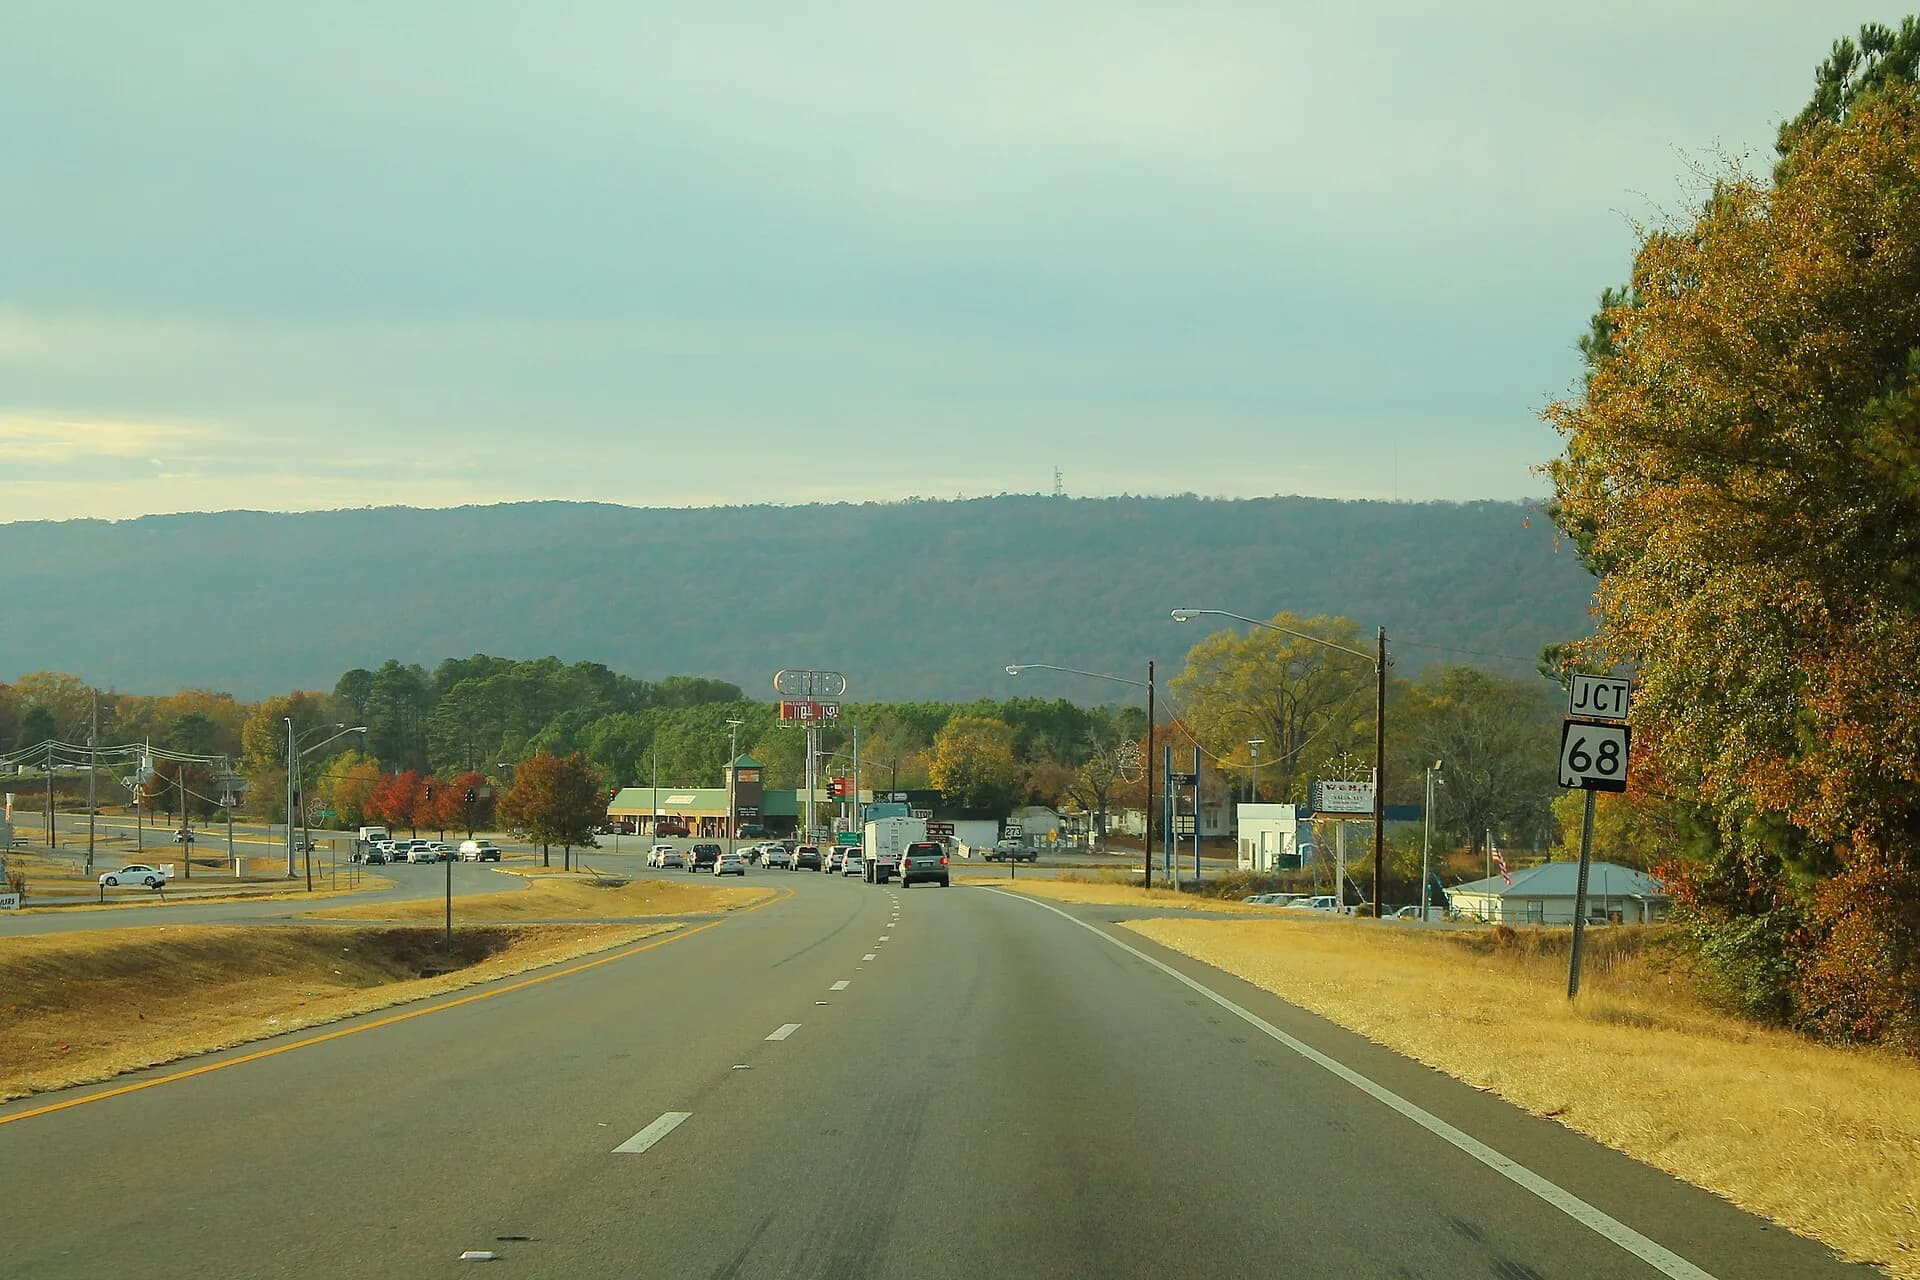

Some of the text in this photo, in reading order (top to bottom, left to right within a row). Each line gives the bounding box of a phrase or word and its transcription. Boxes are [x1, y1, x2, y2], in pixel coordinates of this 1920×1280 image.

[1574, 683, 1626, 712] JCT
[1568, 737, 1620, 775] 68
[1006, 827, 1021, 836] 273
